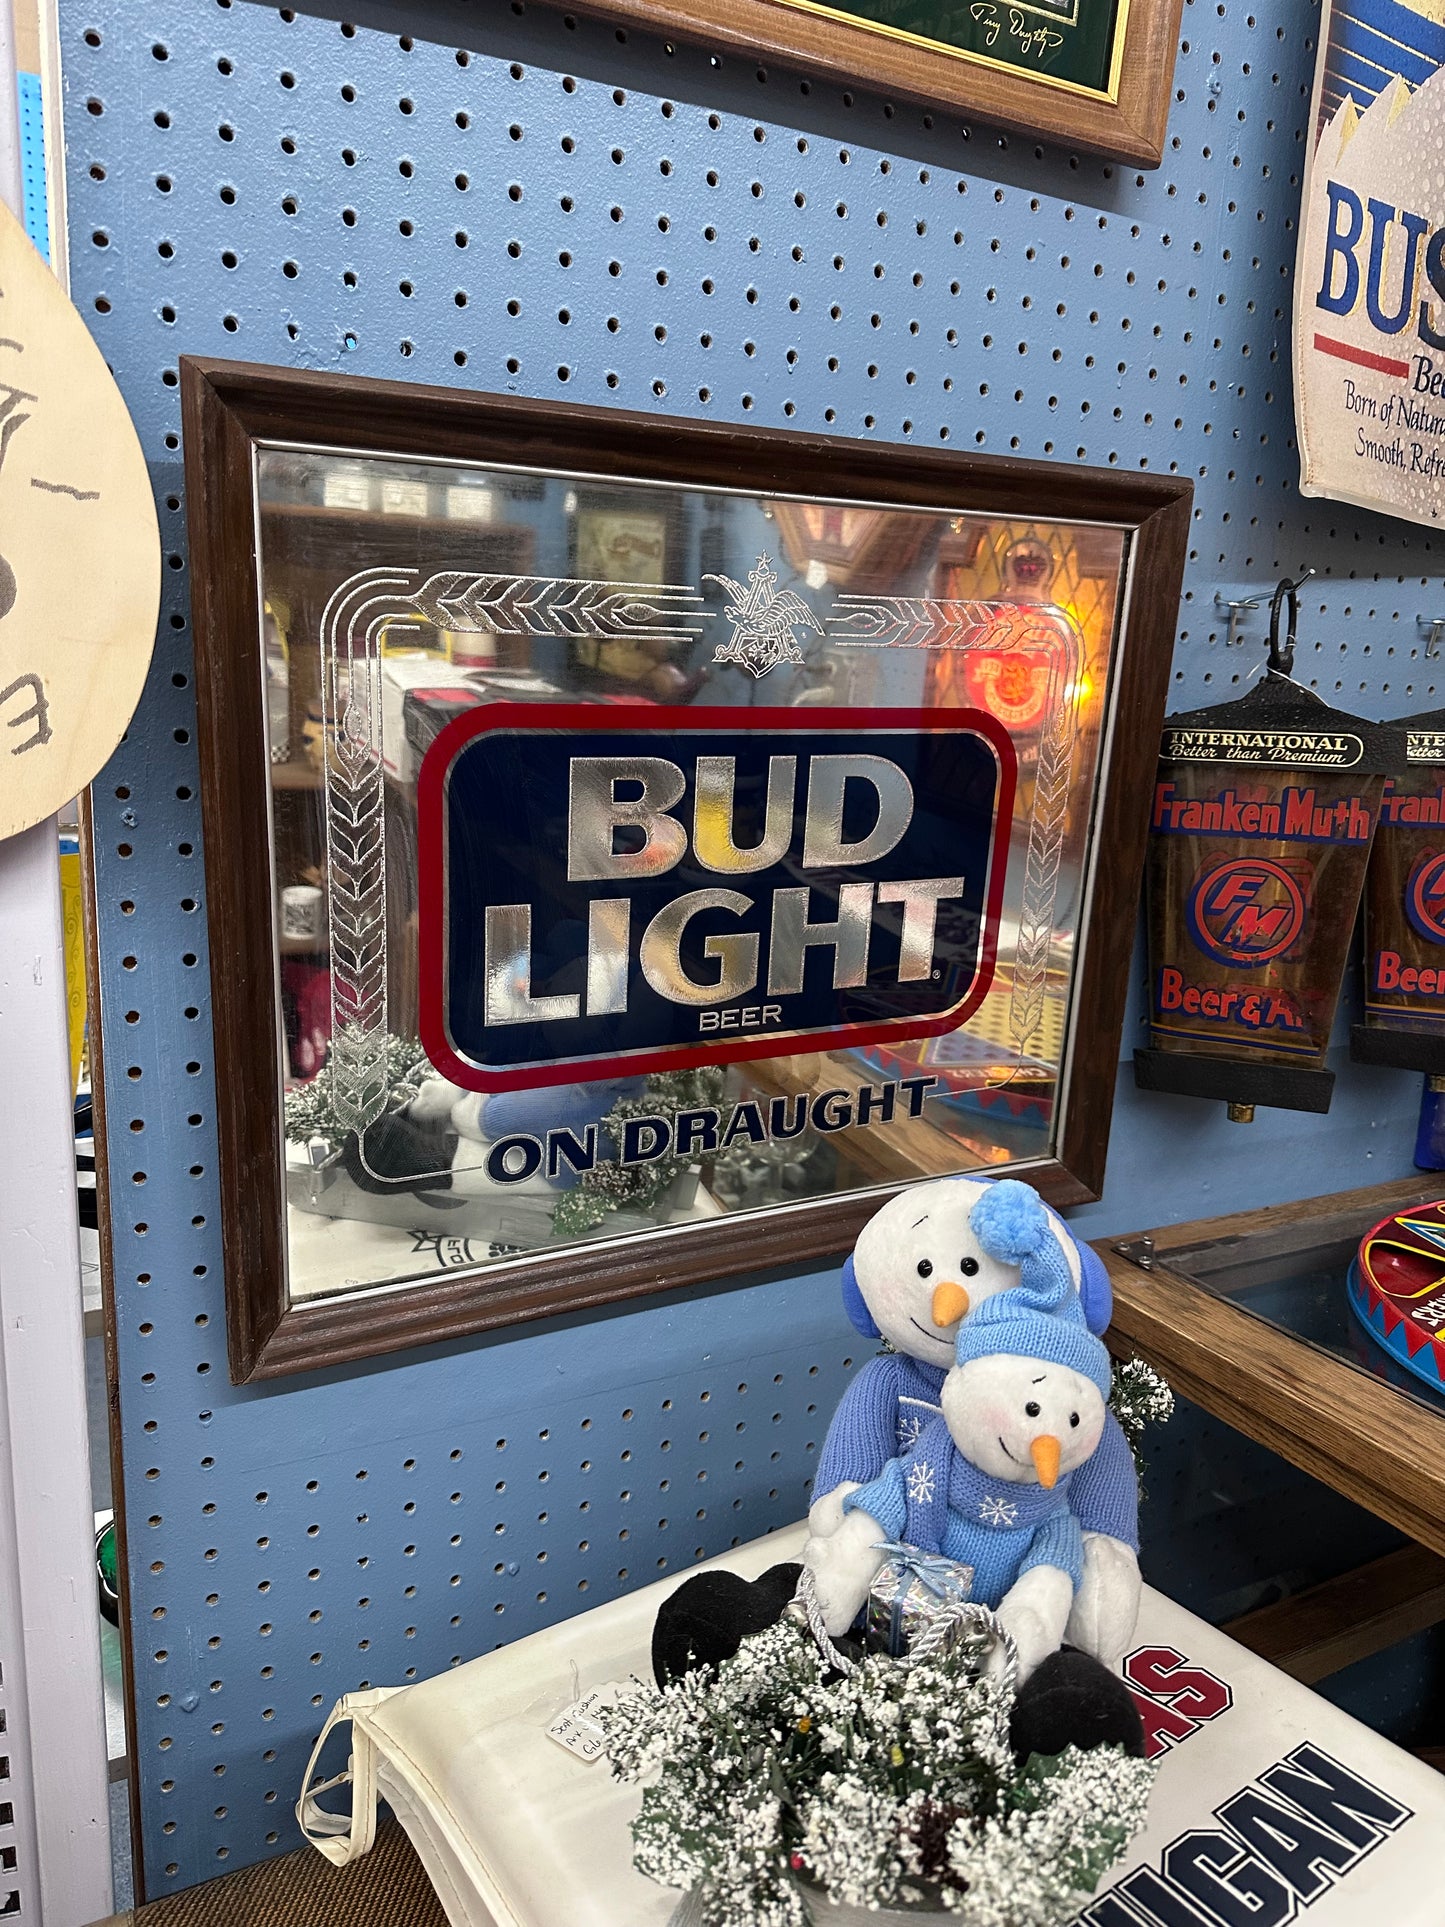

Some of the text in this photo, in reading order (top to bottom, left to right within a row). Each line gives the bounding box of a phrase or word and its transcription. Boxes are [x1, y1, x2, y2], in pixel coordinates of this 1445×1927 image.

[1343, 379, 1376, 418] Born
[1380, 394, 1396, 430] of
[1355, 427, 1406, 472] Smooth,
[1169, 744, 1346, 764] Better than Premium
[1170, 732, 1348, 750] INTERNATIONAL
[567, 755, 914, 882] BUD
[484, 876, 965, 1027] LIGHT
[699, 1004, 782, 1031] BEER
[1160, 968, 1238, 1018] Beer
[482, 1075, 939, 1186] ON DRAUGHT
